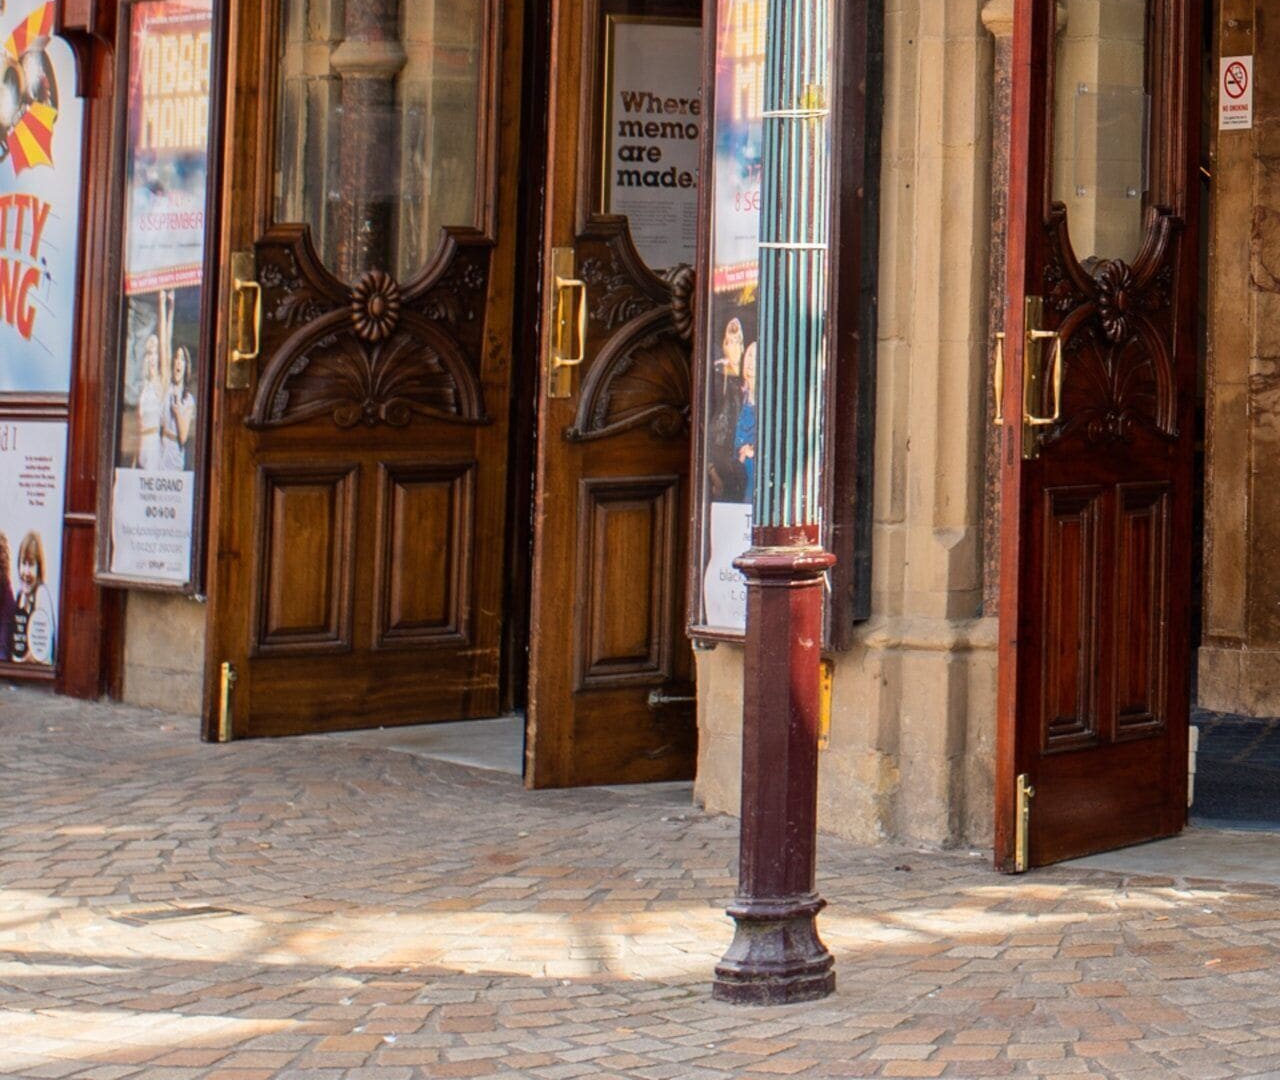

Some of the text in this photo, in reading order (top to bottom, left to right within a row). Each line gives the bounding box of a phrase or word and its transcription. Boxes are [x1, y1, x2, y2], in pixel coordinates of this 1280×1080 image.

[620, 90, 701, 116] Where
[618, 142, 662, 163] are
[616, 166, 697, 189] made.
[139, 477, 184, 493] THE GRAND
